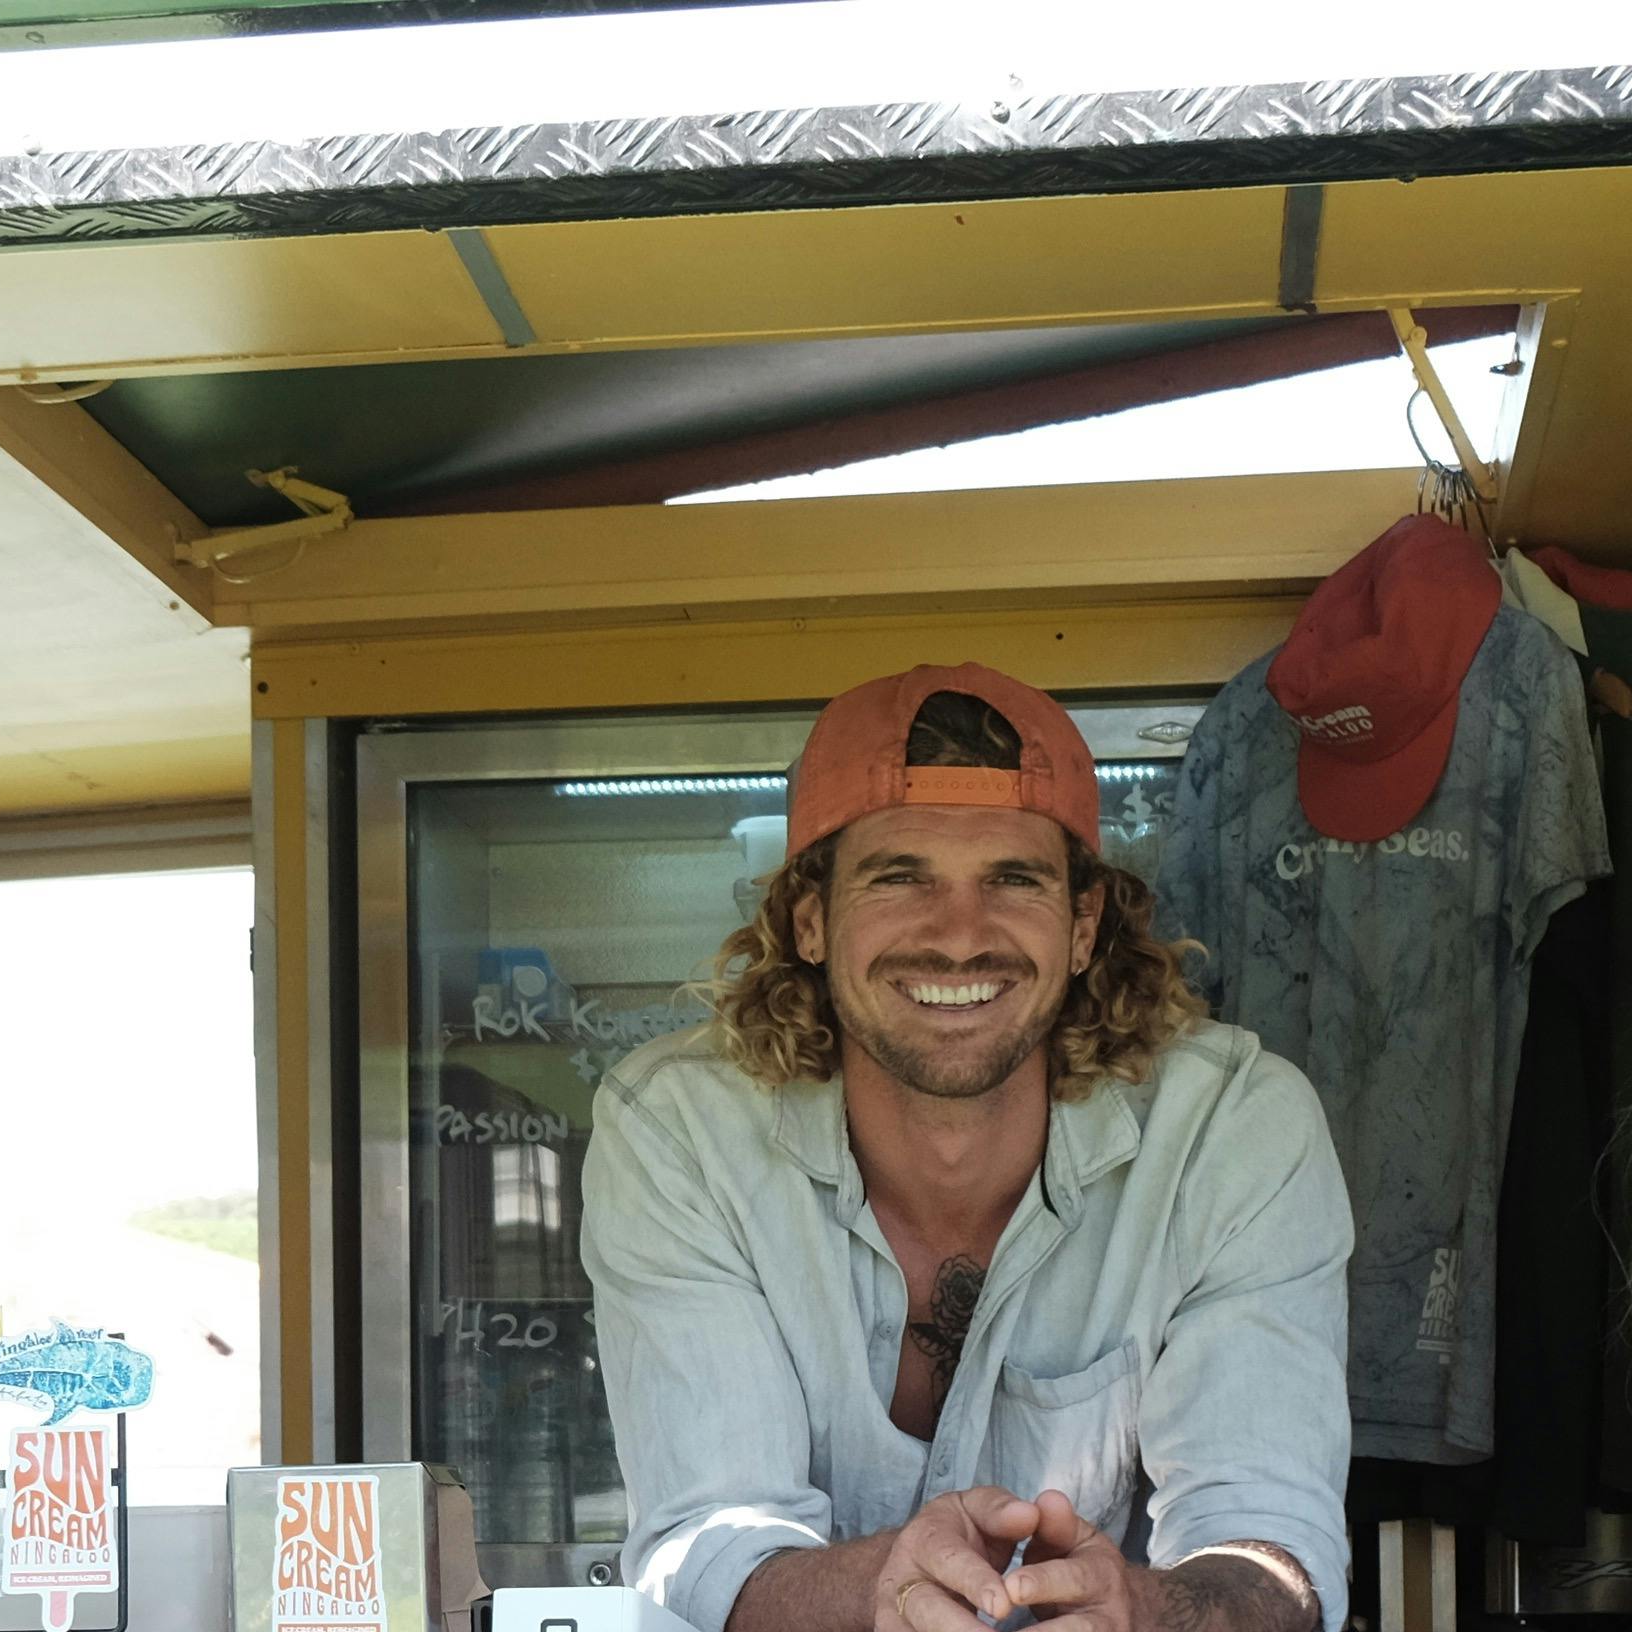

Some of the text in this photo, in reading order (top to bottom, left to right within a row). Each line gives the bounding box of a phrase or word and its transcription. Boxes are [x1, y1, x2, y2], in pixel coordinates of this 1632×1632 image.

[434, 1103, 568, 1148] PASSION
[1429, 1247, 1462, 1298] SU
[14, 1431, 107, 1514] SUN
[11, 1489, 109, 1551] CREAM
[280, 1482, 375, 1565] SUN
[10, 1541, 111, 1566] NINGALOO
[278, 1540, 378, 1602] CREAM
[277, 1591, 381, 1616] NINGALOO
